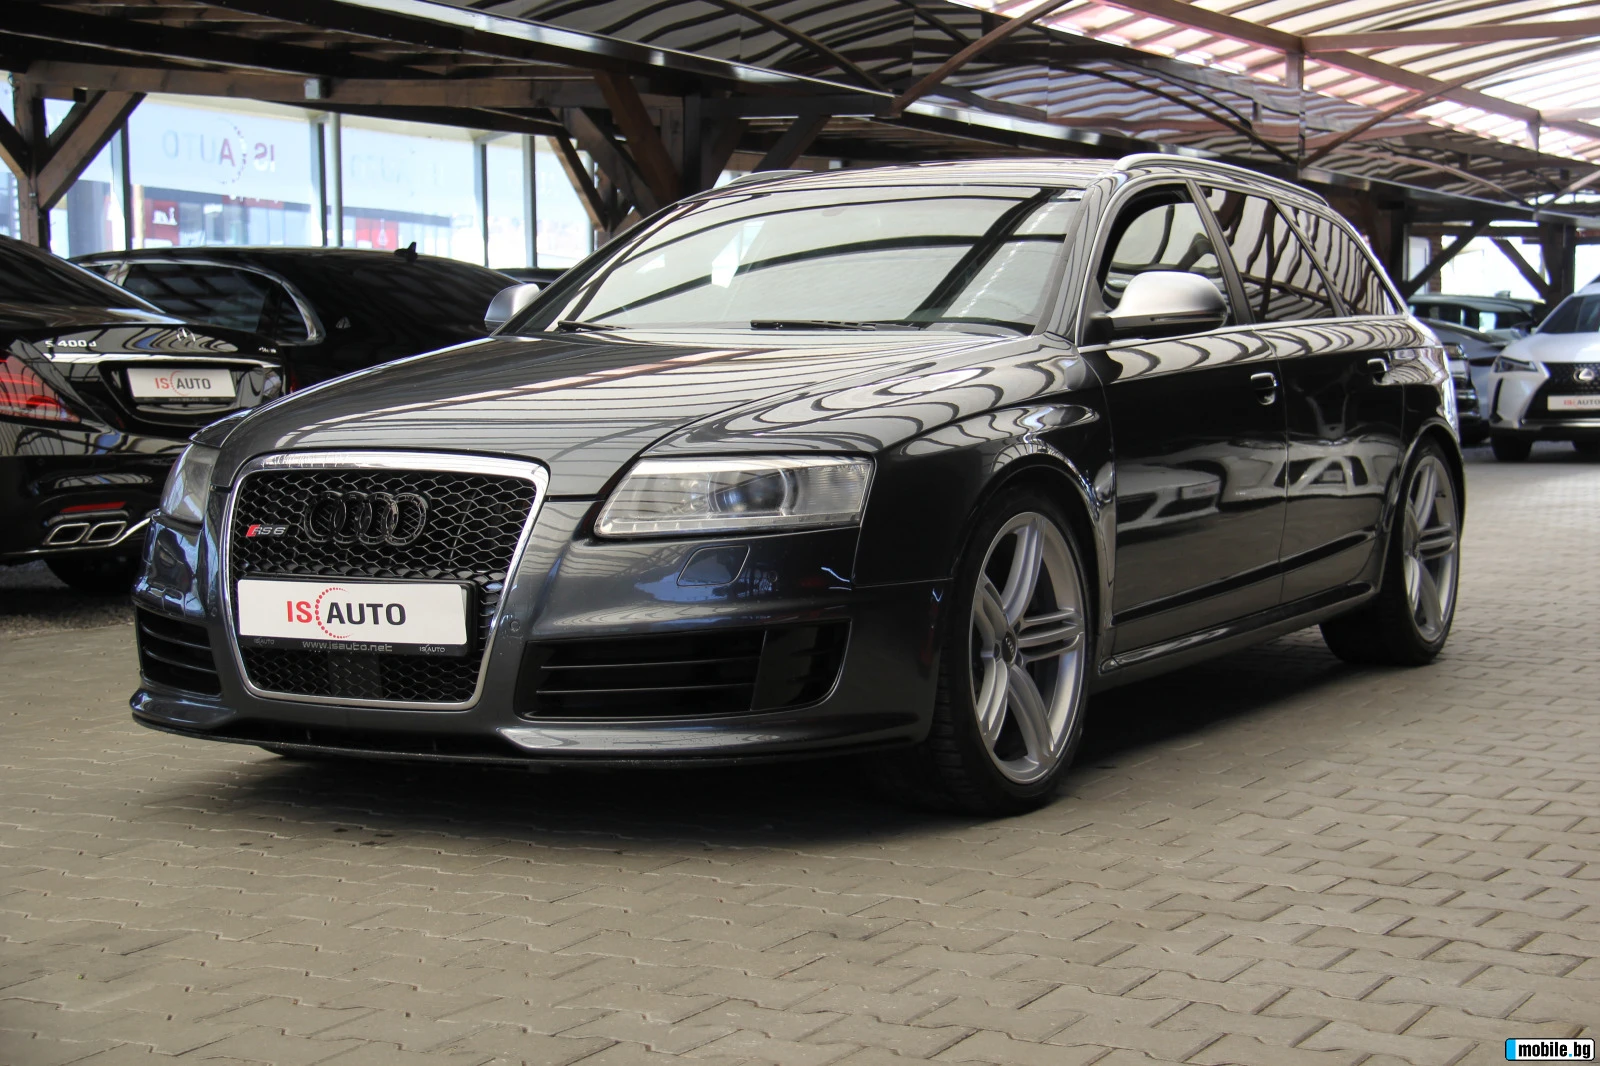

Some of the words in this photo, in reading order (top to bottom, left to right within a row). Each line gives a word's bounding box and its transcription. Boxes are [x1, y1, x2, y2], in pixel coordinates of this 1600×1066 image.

[155, 377, 170, 389] IS
[177, 378, 211, 390] AUTO
[286, 600, 313, 624] IS
[326, 602, 407, 626] AUTO
[302, 641, 393, 652] www.isauto.net
